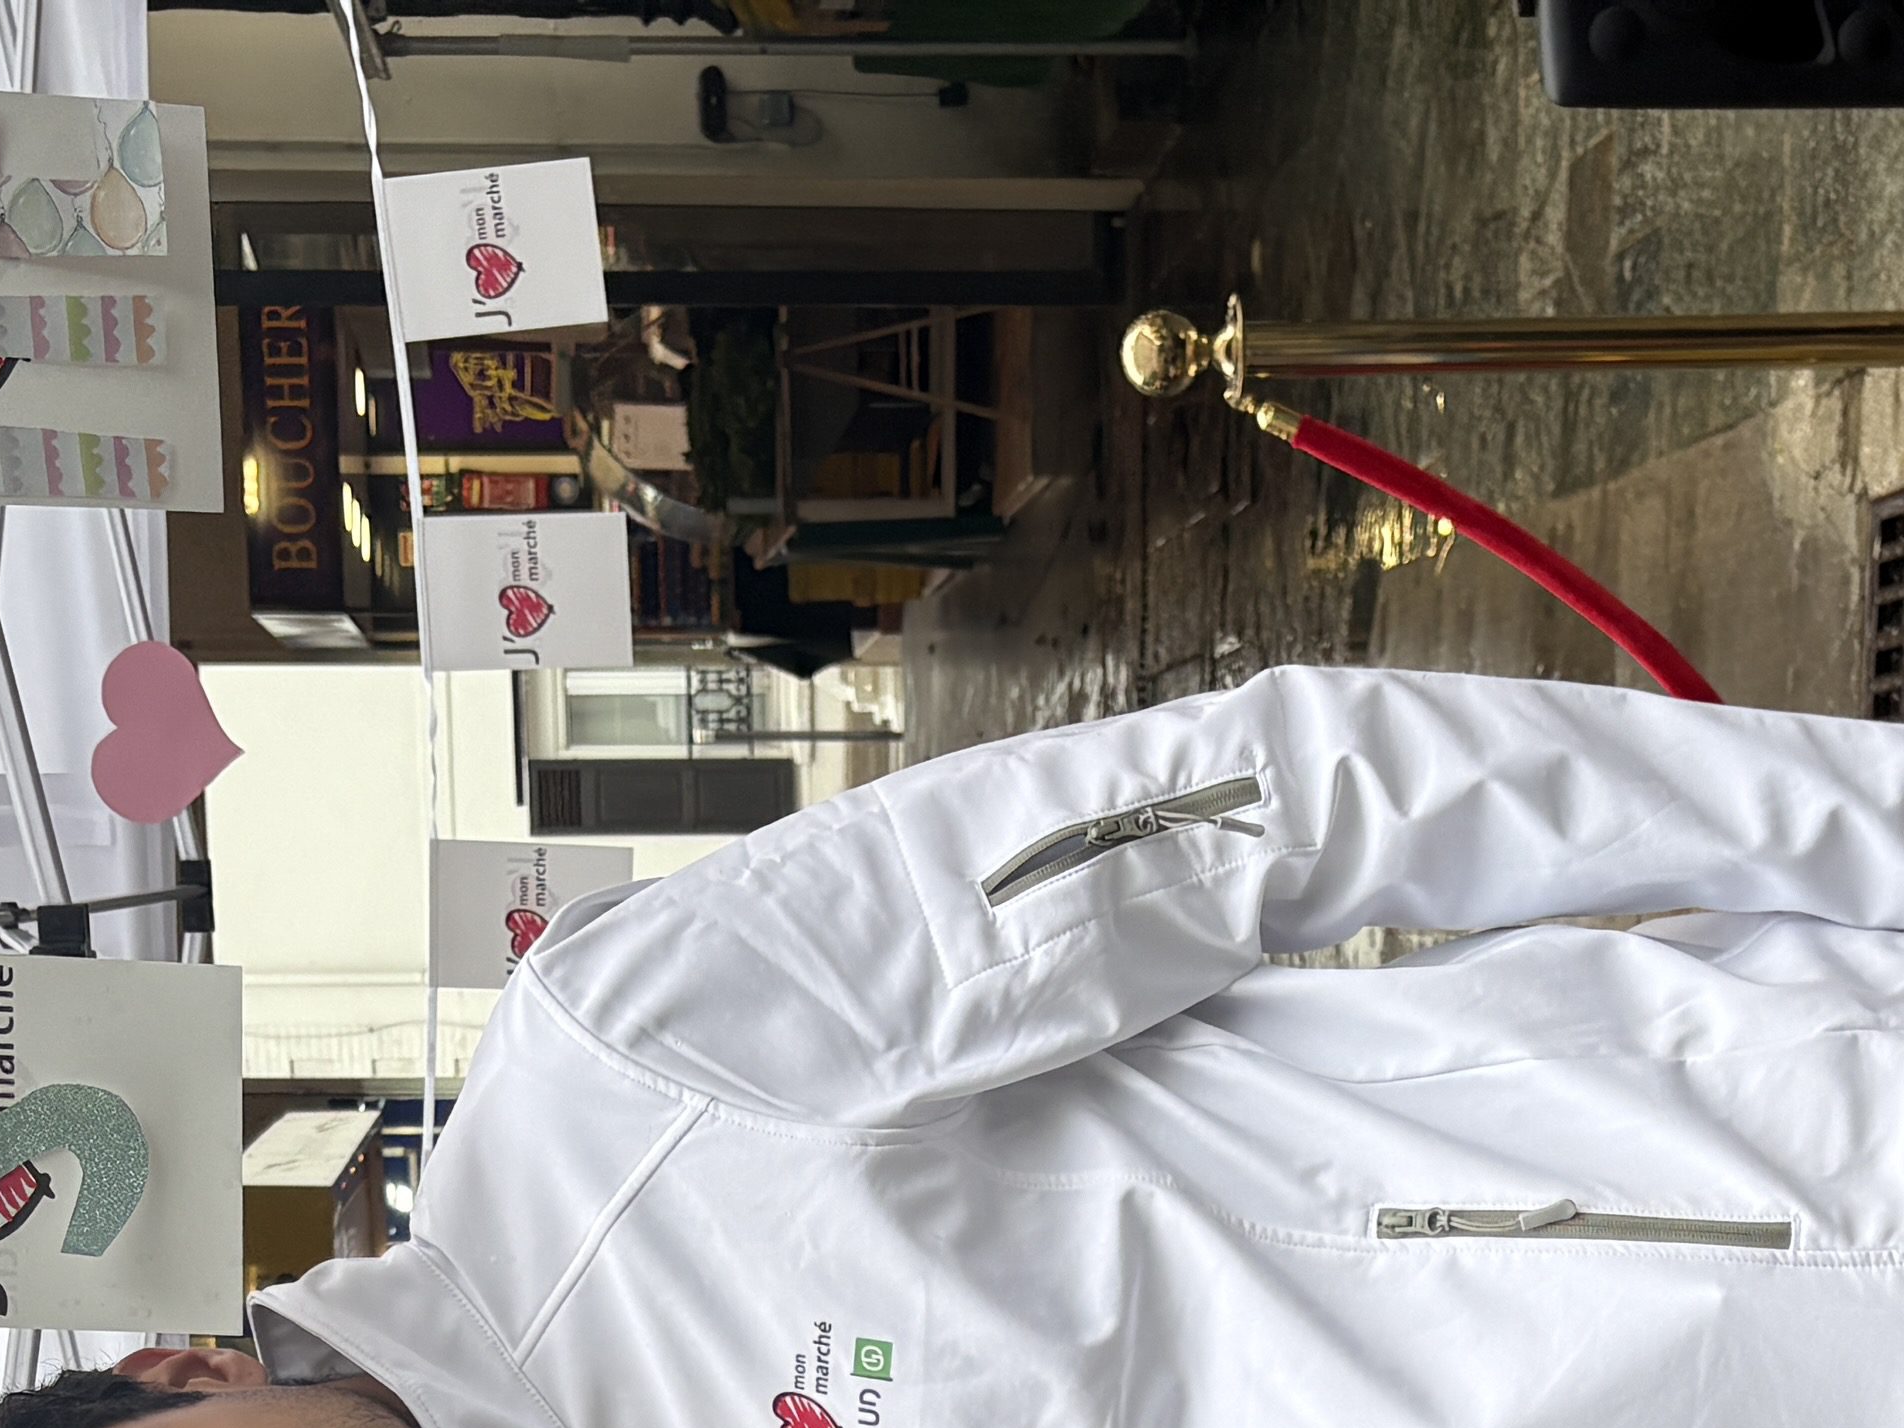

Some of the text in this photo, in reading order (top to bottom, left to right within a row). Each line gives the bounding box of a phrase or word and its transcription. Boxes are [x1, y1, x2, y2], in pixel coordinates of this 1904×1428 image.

[473, 206, 489, 241] mon
[482, 171, 507, 239] marché
[509, 550, 522, 582] mon
[520, 518, 540, 582] marché
[518, 875, 530, 907] mon
[532, 846, 548, 908] marché
[790, 1353, 808, 1391] mon
[811, 1320, 834, 1397] marché
